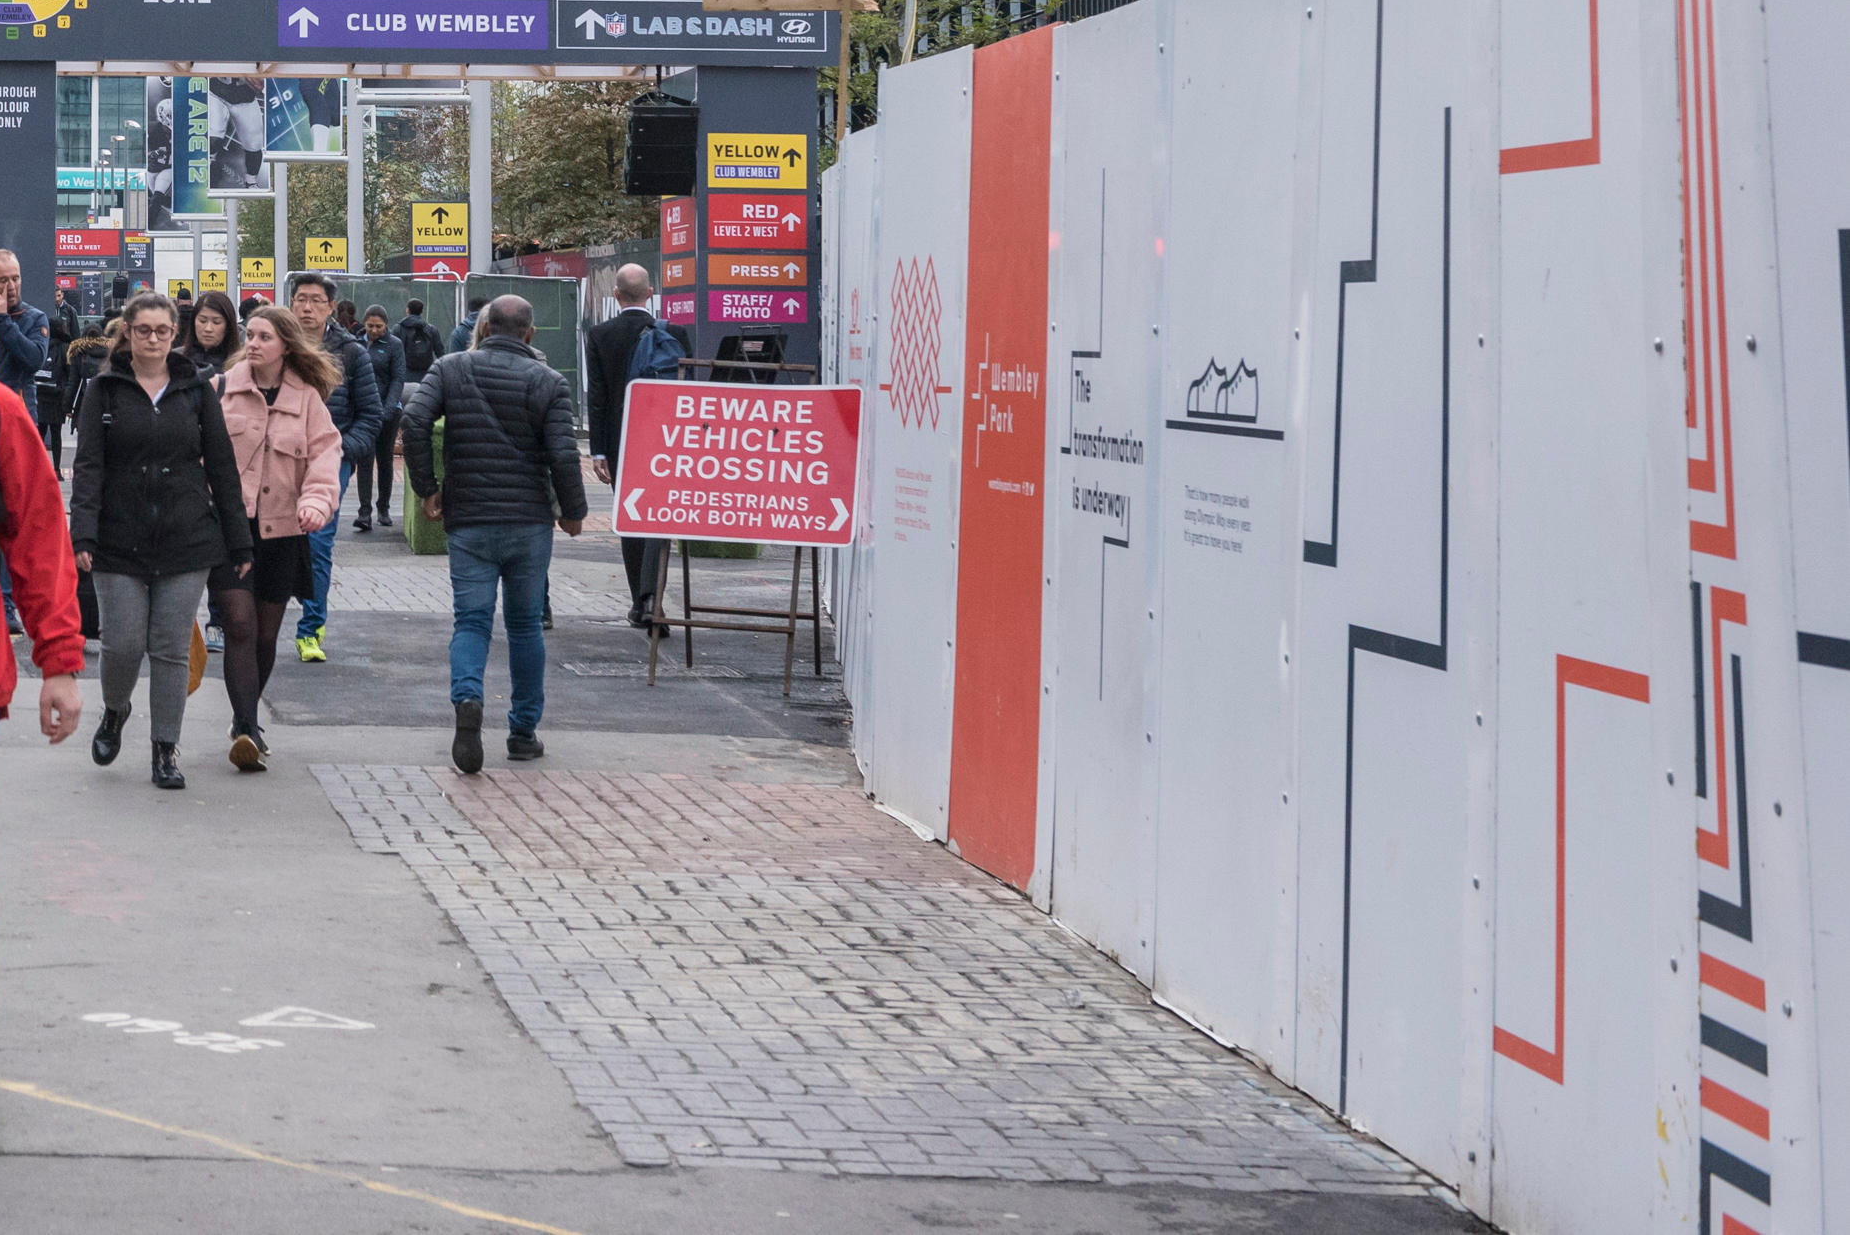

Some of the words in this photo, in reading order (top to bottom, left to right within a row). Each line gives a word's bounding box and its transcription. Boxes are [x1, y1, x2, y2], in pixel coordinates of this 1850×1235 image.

[346, 13, 407, 32] CLUB
[416, 14, 536, 33] WEMBLEY
[608, 23, 624, 33] NFL
[633, 17, 682, 35] LAB
[686, 17, 702, 35] &
[706, 17, 772, 36] DASH
[188, 99, 208, 152] ARE
[714, 145, 780, 158] YELLOW
[188, 159, 207, 183] 12
[715, 166, 735, 178] CLUB
[738, 166, 779, 179] WEMBLEY
[742, 204, 779, 219] RED
[60, 235, 82, 243] RED
[416, 227, 464, 236] YELLOW
[714, 225, 742, 237] LEVEL
[744, 226, 750, 237] 2
[752, 226, 778, 237] WEST
[731, 265, 779, 277] PRESS
[722, 294, 774, 307] STAFF/
[723, 306, 771, 318] PHOTO
[992, 363, 1039, 400] Wembley
[1075, 370, 1091, 403] The
[676, 396, 814, 424] BEWARE
[990, 403, 1014, 433] Park
[662, 424, 824, 455] VEHICLES
[1074, 426, 1144, 465] transformation
[650, 453, 829, 485] CROSSING
[668, 491, 809, 512] PEDESTRIANS
[1073, 477, 1080, 510] is
[1082, 481, 1126, 527] underway
[648, 507, 705, 523] LOOK
[708, 510, 766, 527] BOTH
[770, 513, 827, 531] WAYS
